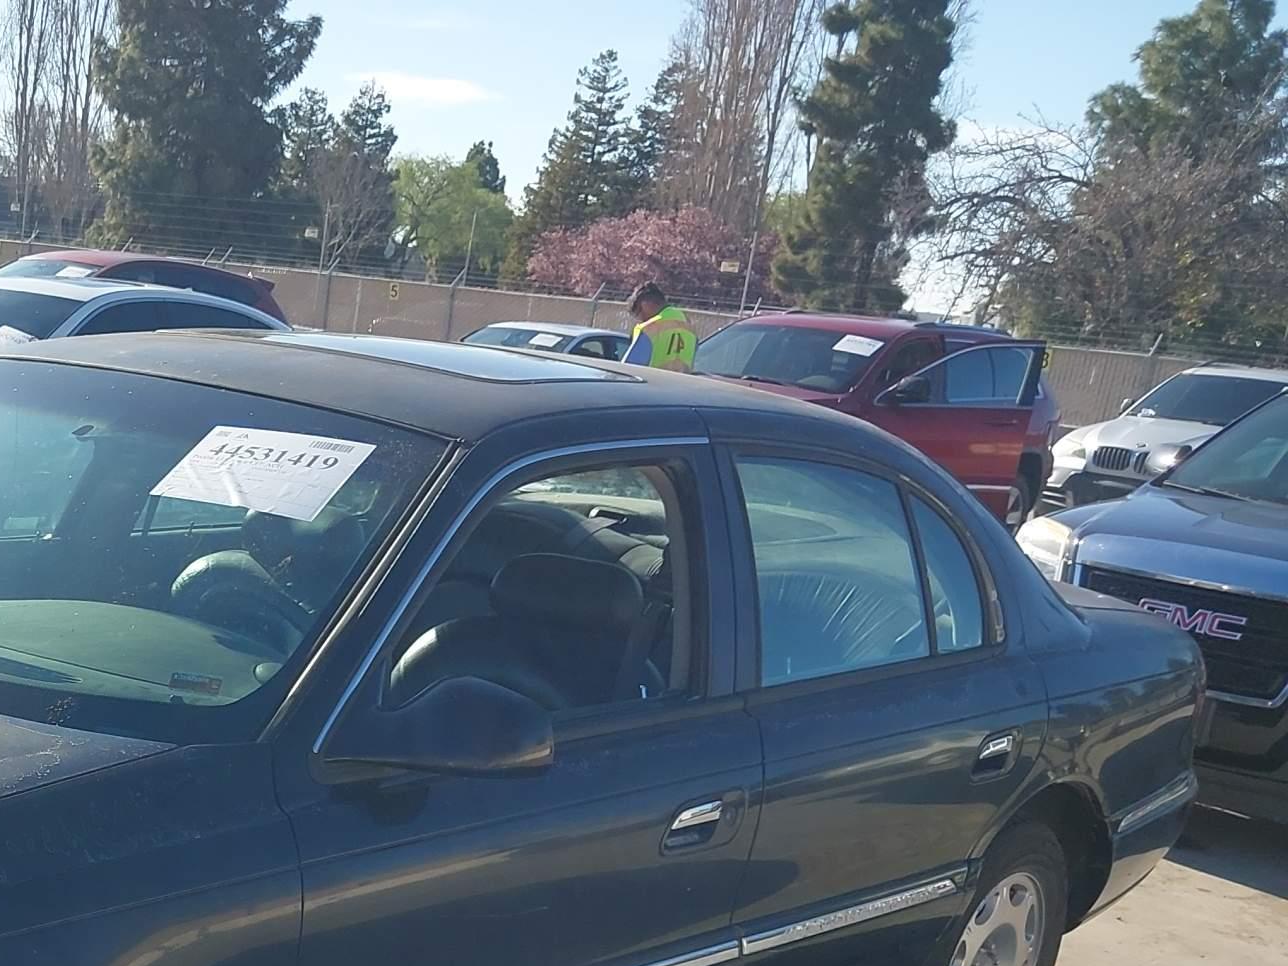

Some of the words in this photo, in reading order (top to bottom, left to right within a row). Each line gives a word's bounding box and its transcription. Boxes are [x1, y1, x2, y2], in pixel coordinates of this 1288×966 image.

[390, 284, 399, 298] 5
[209, 442, 340, 471] 44531419
[1138, 597, 1248, 640] GMC
